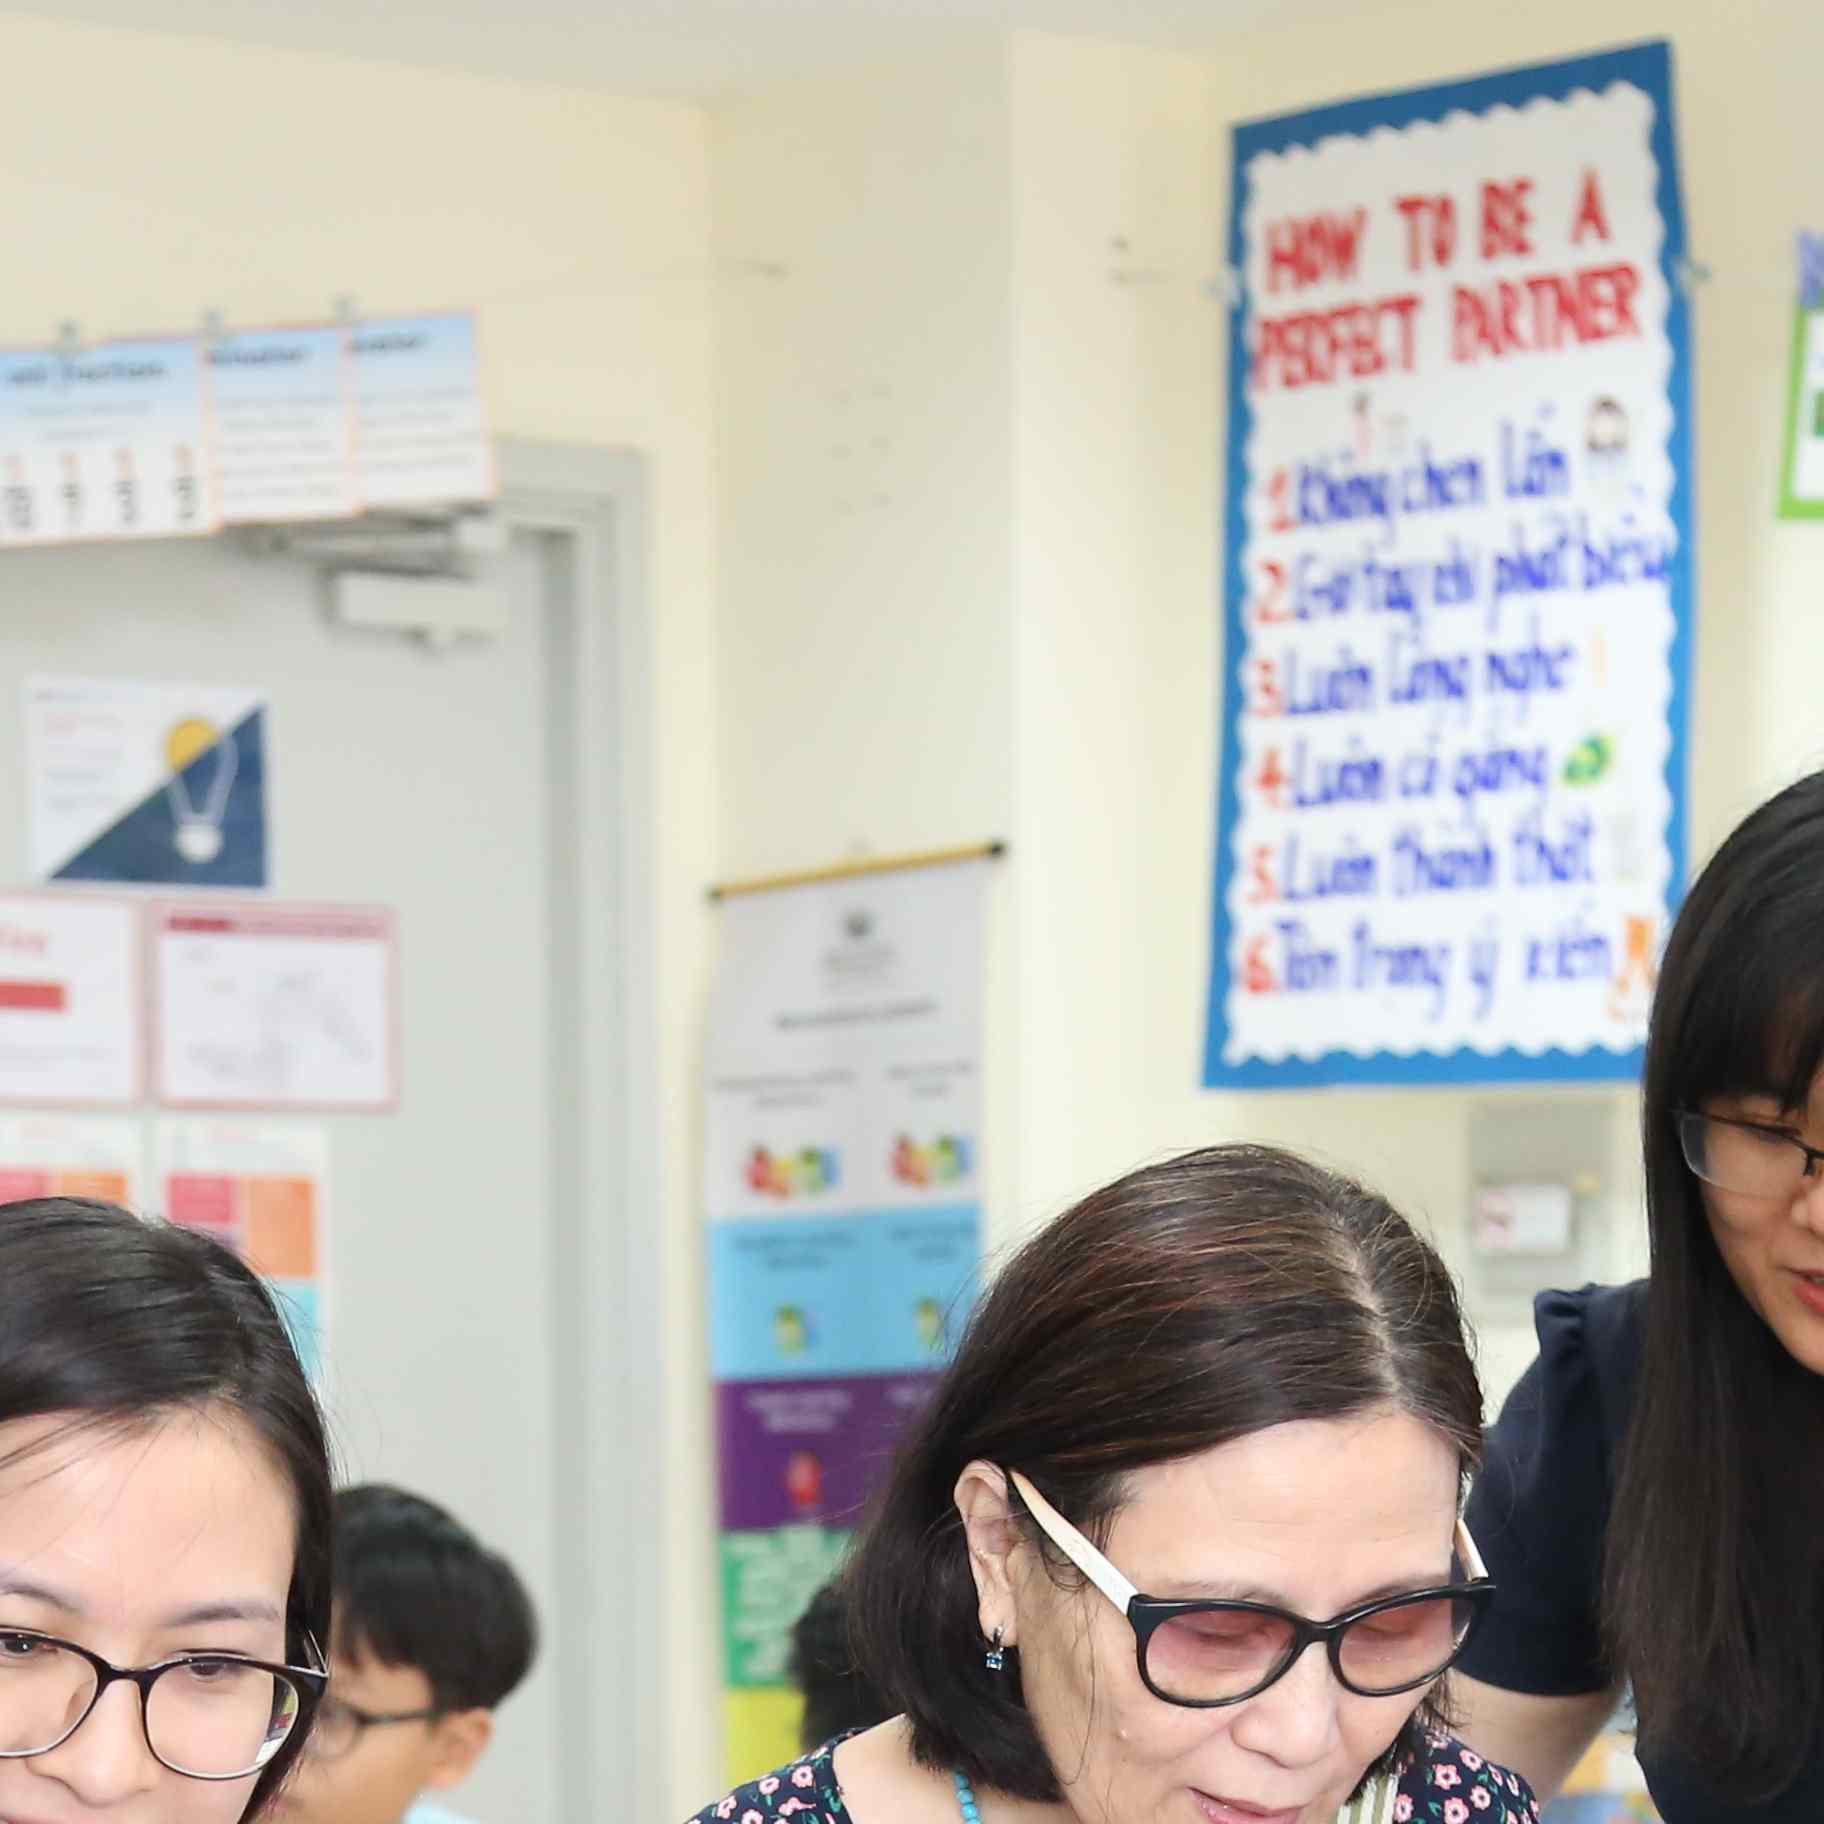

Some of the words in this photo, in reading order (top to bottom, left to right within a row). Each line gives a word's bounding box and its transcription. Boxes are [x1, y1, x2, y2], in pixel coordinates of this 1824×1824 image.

[1265, 205, 1368, 296] HOW
[1394, 194, 1458, 273] TO
[1479, 176, 1536, 261] BE
[1570, 166, 1610, 246] A
[1254, 295, 1422, 393] PERFECT
[1451, 262, 1646, 360] PARTNER
